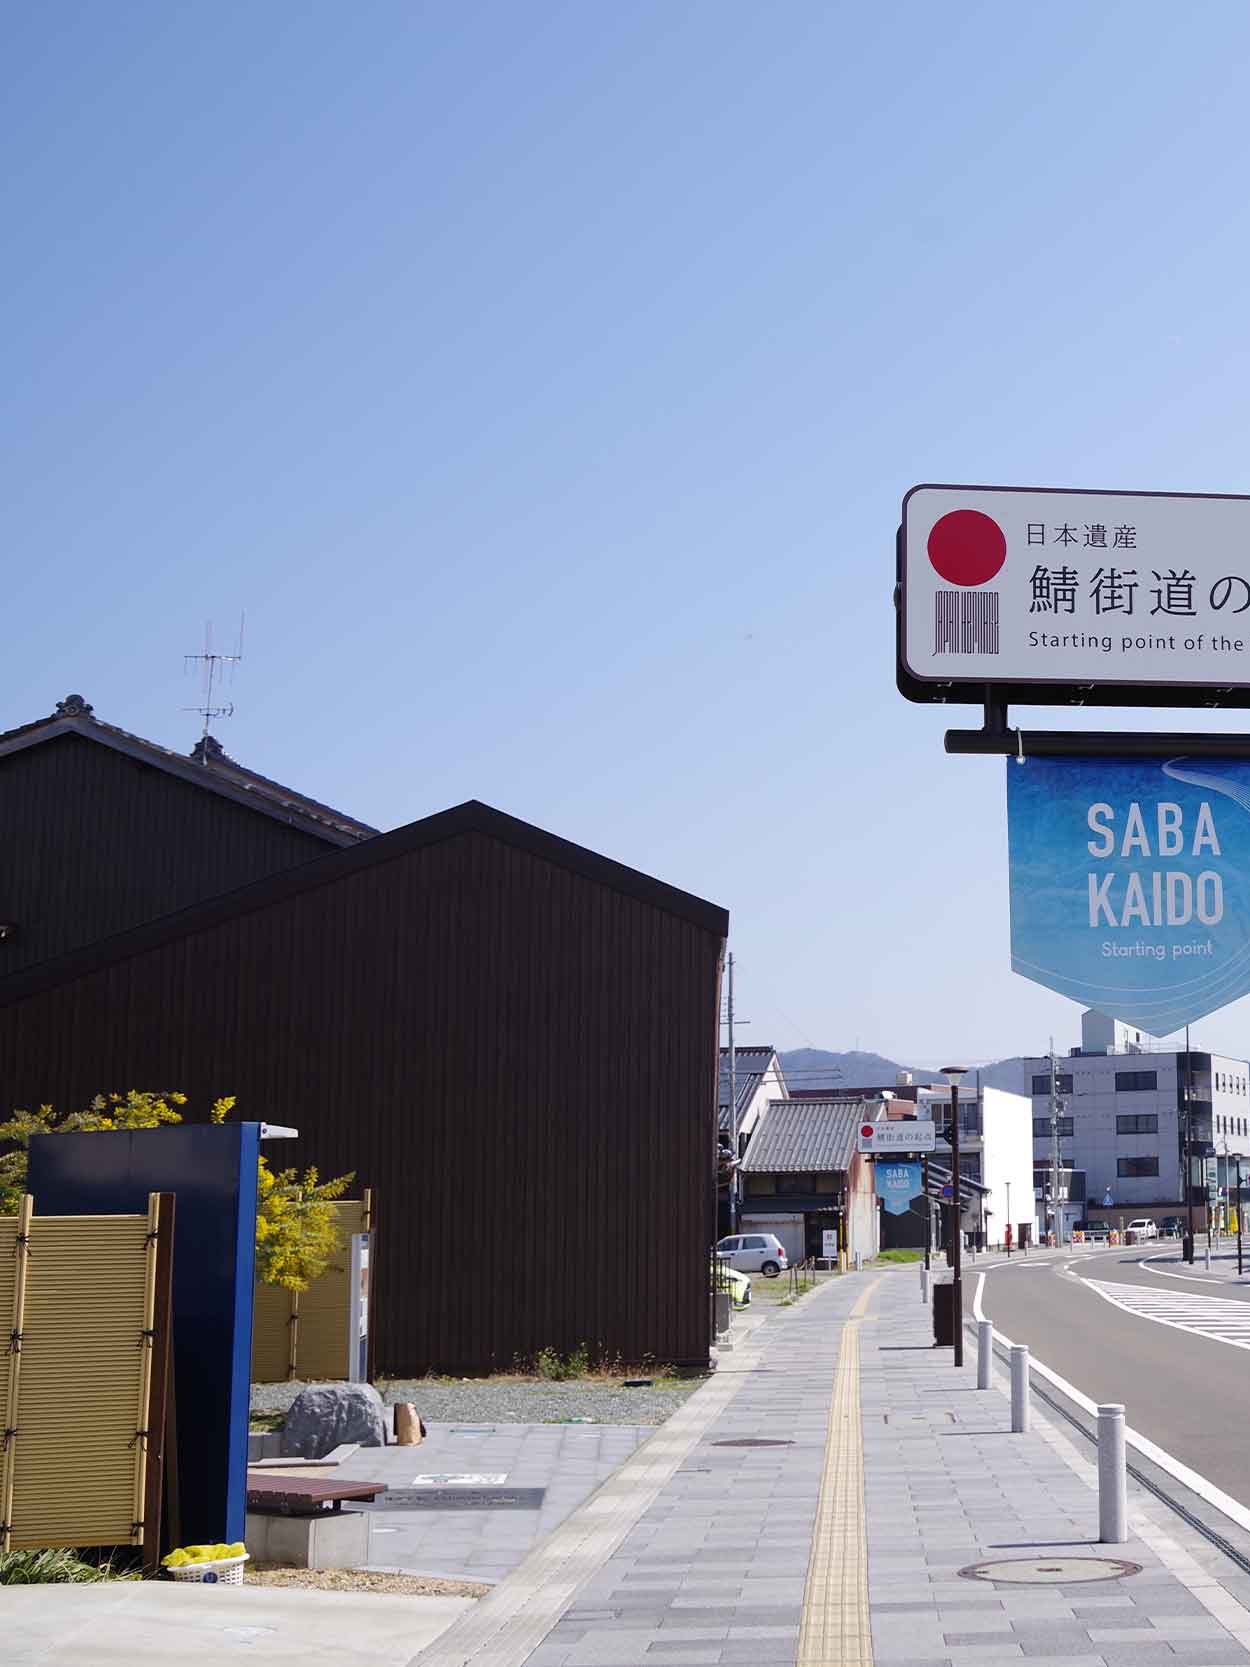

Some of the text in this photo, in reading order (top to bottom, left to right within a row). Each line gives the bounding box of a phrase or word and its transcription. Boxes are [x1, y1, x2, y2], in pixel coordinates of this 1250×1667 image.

[1025, 523, 1137, 550] 日本遺産
[1029, 631, 1113, 653] Starting
[1121, 633, 1176, 653] point
[1183, 633, 1207, 651] of
[1210, 634, 1244, 653] the
[1088, 802, 1222, 858] SABA
[1088, 871, 1224, 928] KAIDO
[1101, 940, 1214, 961] Starting point
